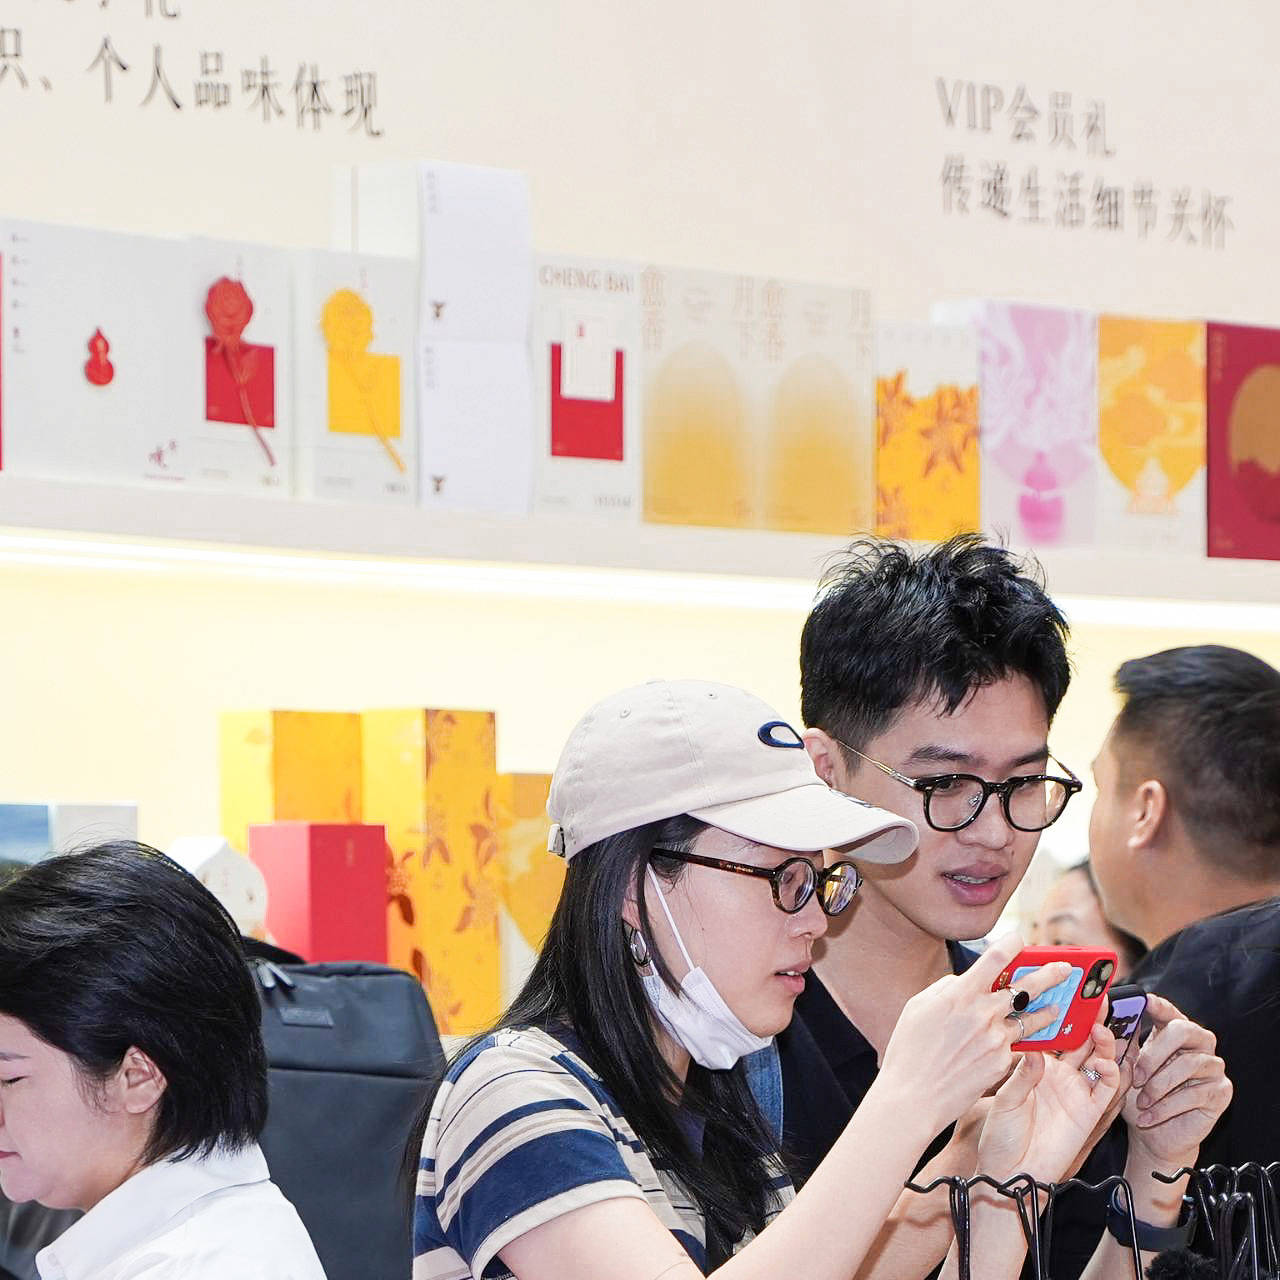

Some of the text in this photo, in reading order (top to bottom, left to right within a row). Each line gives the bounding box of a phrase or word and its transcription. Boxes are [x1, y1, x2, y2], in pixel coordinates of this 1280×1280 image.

[936, 76, 1116, 158] VIP会员礼
[939, 155, 1234, 250] 传递生活细节关怀
